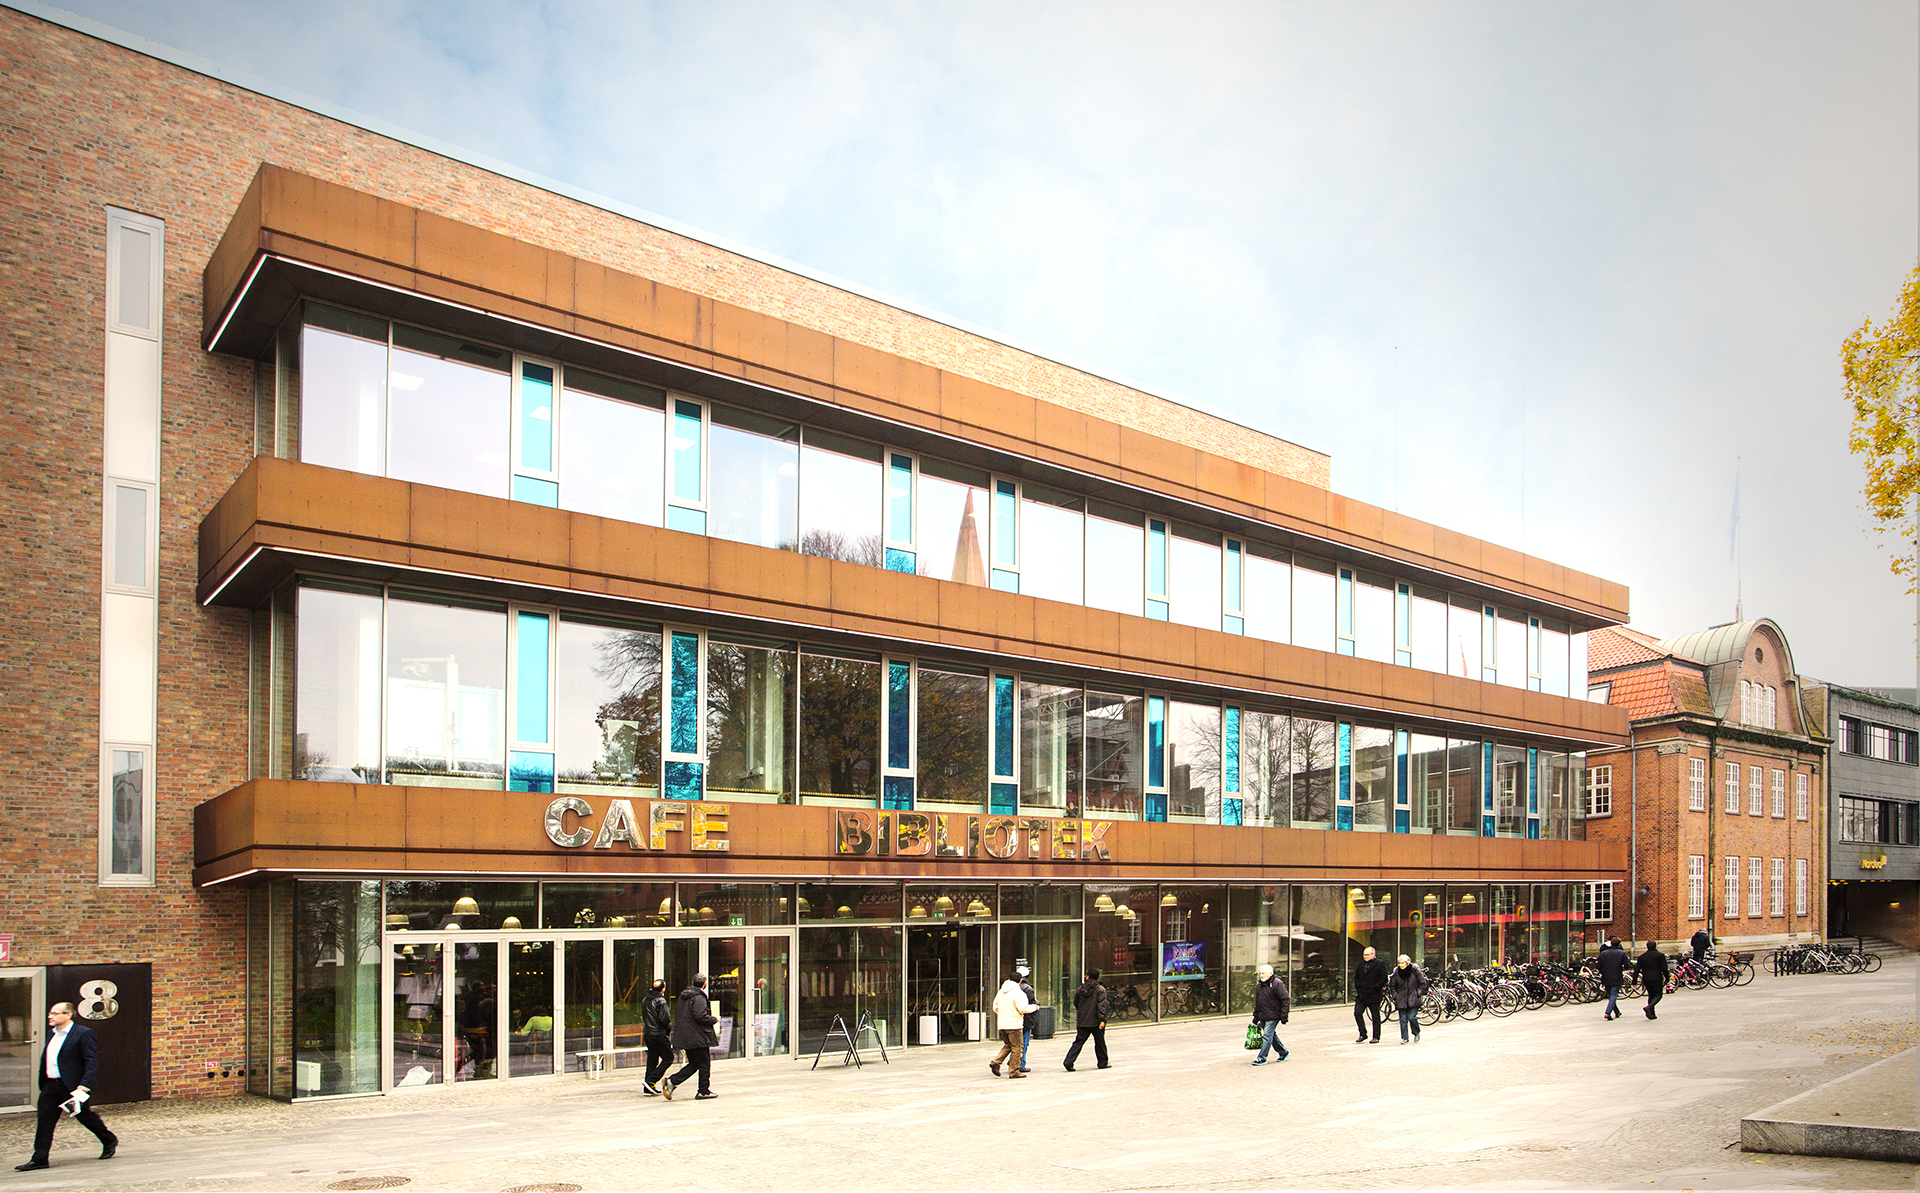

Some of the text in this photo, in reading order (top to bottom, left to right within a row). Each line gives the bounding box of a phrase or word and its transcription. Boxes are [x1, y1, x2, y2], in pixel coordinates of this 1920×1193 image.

[544, 796, 1113, 860] CAFE BIBLIOTEK
[1172, 945, 1198, 960] FAME
[77, 979, 119, 1020] 8
